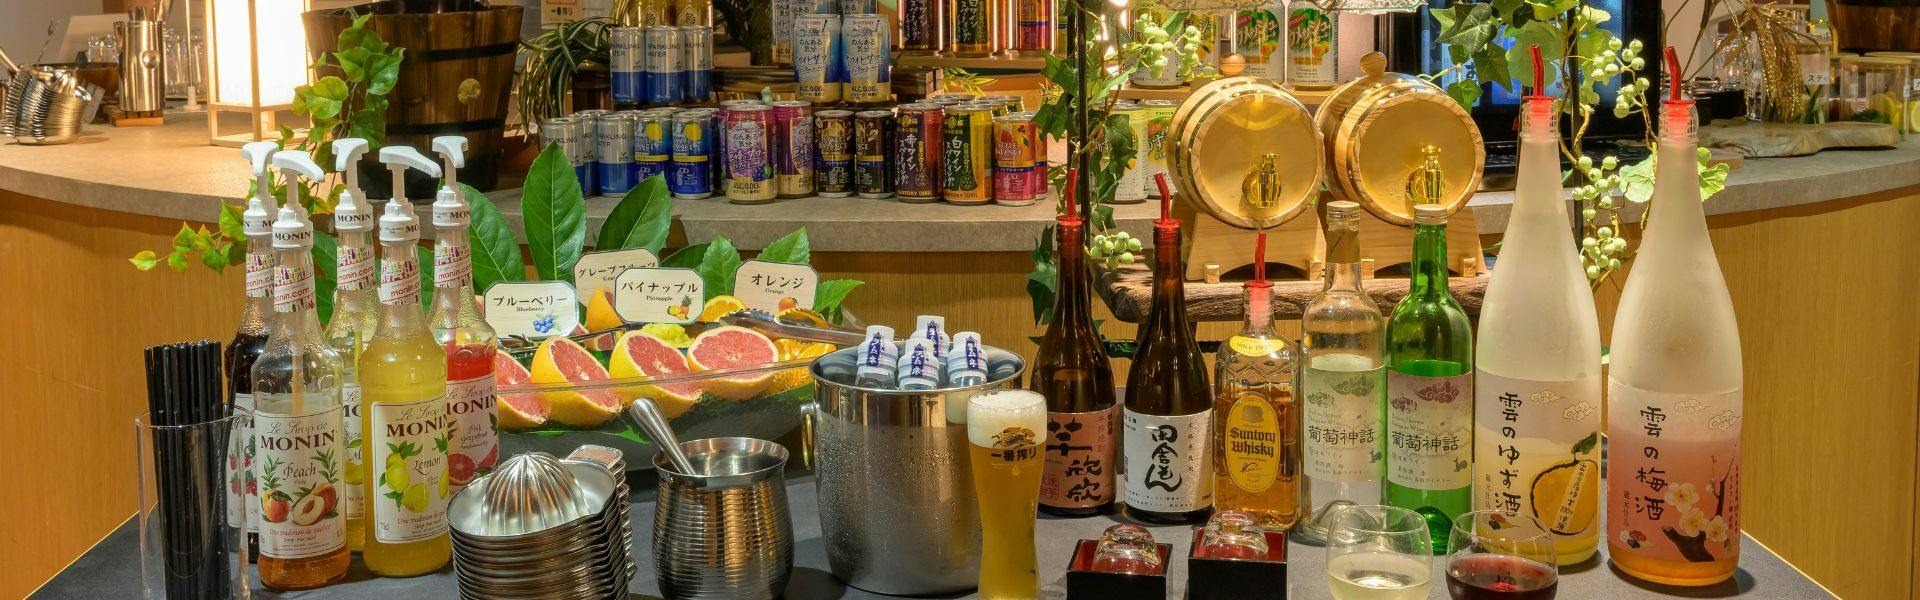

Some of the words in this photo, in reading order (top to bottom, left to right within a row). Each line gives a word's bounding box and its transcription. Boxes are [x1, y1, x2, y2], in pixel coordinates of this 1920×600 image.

[336, 213, 372, 223] MONIN
[274, 230, 312, 241] MONIN
[621, 280, 699, 294] パイナップル
[751, 273, 805, 290] オレンジ
[764, 287, 785, 295] Orange
[492, 295, 568, 307] ブルーベリー
[260, 430, 336, 451] MONIN
[1229, 427, 1276, 443] Suntory
[1308, 425, 1376, 446] 葡萄神話
[1391, 430, 1461, 453] 葡萄神話
[990, 446, 1037, 462] 一番搾り
[1144, 424, 1183, 492] 田舎もん
[1231, 441, 1274, 458] Whisky
[1494, 392, 1522, 518] 雲のゆず酒
[282, 462, 316, 481] Peach
[413, 456, 441, 476] Lemon
[1635, 405, 1668, 521] 雲の梅酒
